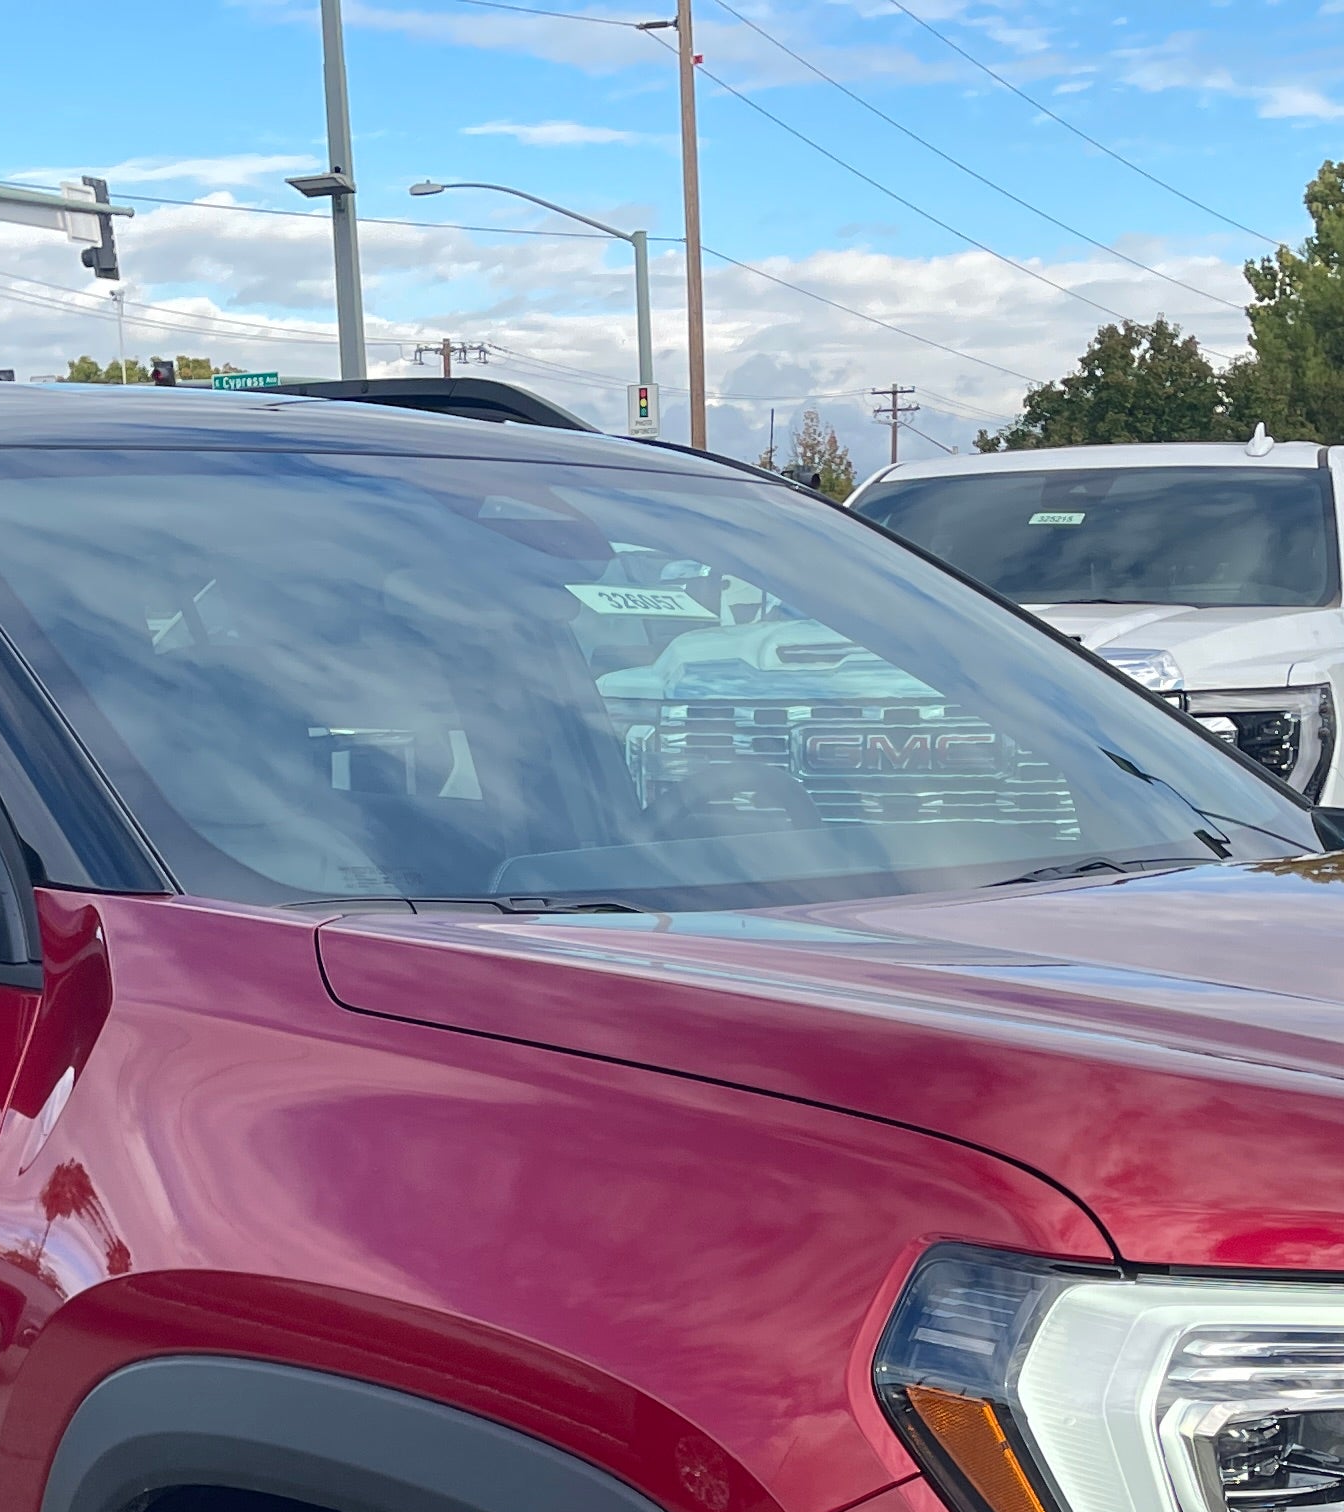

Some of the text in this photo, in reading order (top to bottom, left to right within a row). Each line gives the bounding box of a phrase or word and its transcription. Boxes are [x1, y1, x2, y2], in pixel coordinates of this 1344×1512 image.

[222, 376, 264, 390] Cypress
[598, 592, 686, 611] 326057
[806, 734, 996, 771] GMC
